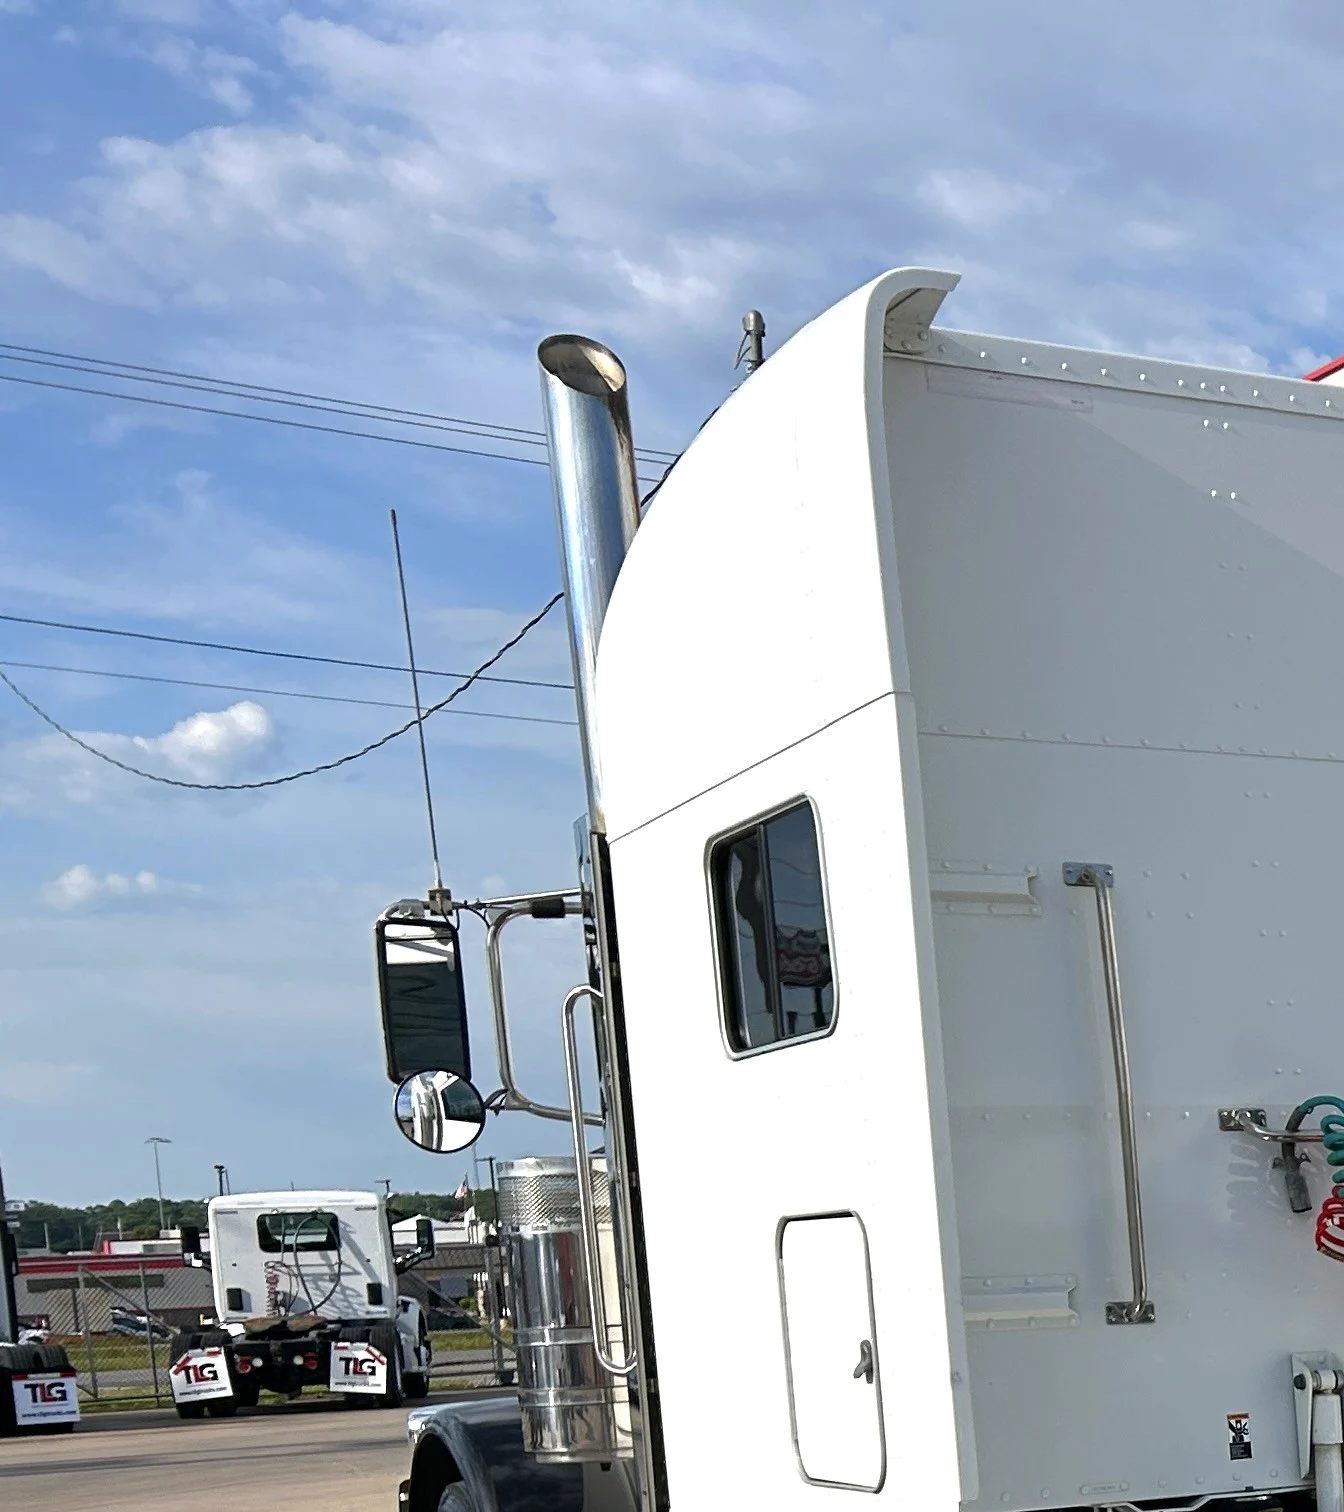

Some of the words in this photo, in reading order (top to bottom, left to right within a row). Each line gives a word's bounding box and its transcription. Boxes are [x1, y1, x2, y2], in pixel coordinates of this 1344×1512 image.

[180, 1363, 219, 1384] TLG
[338, 1356, 377, 1376] TLG
[24, 1382, 68, 1403] TLG
